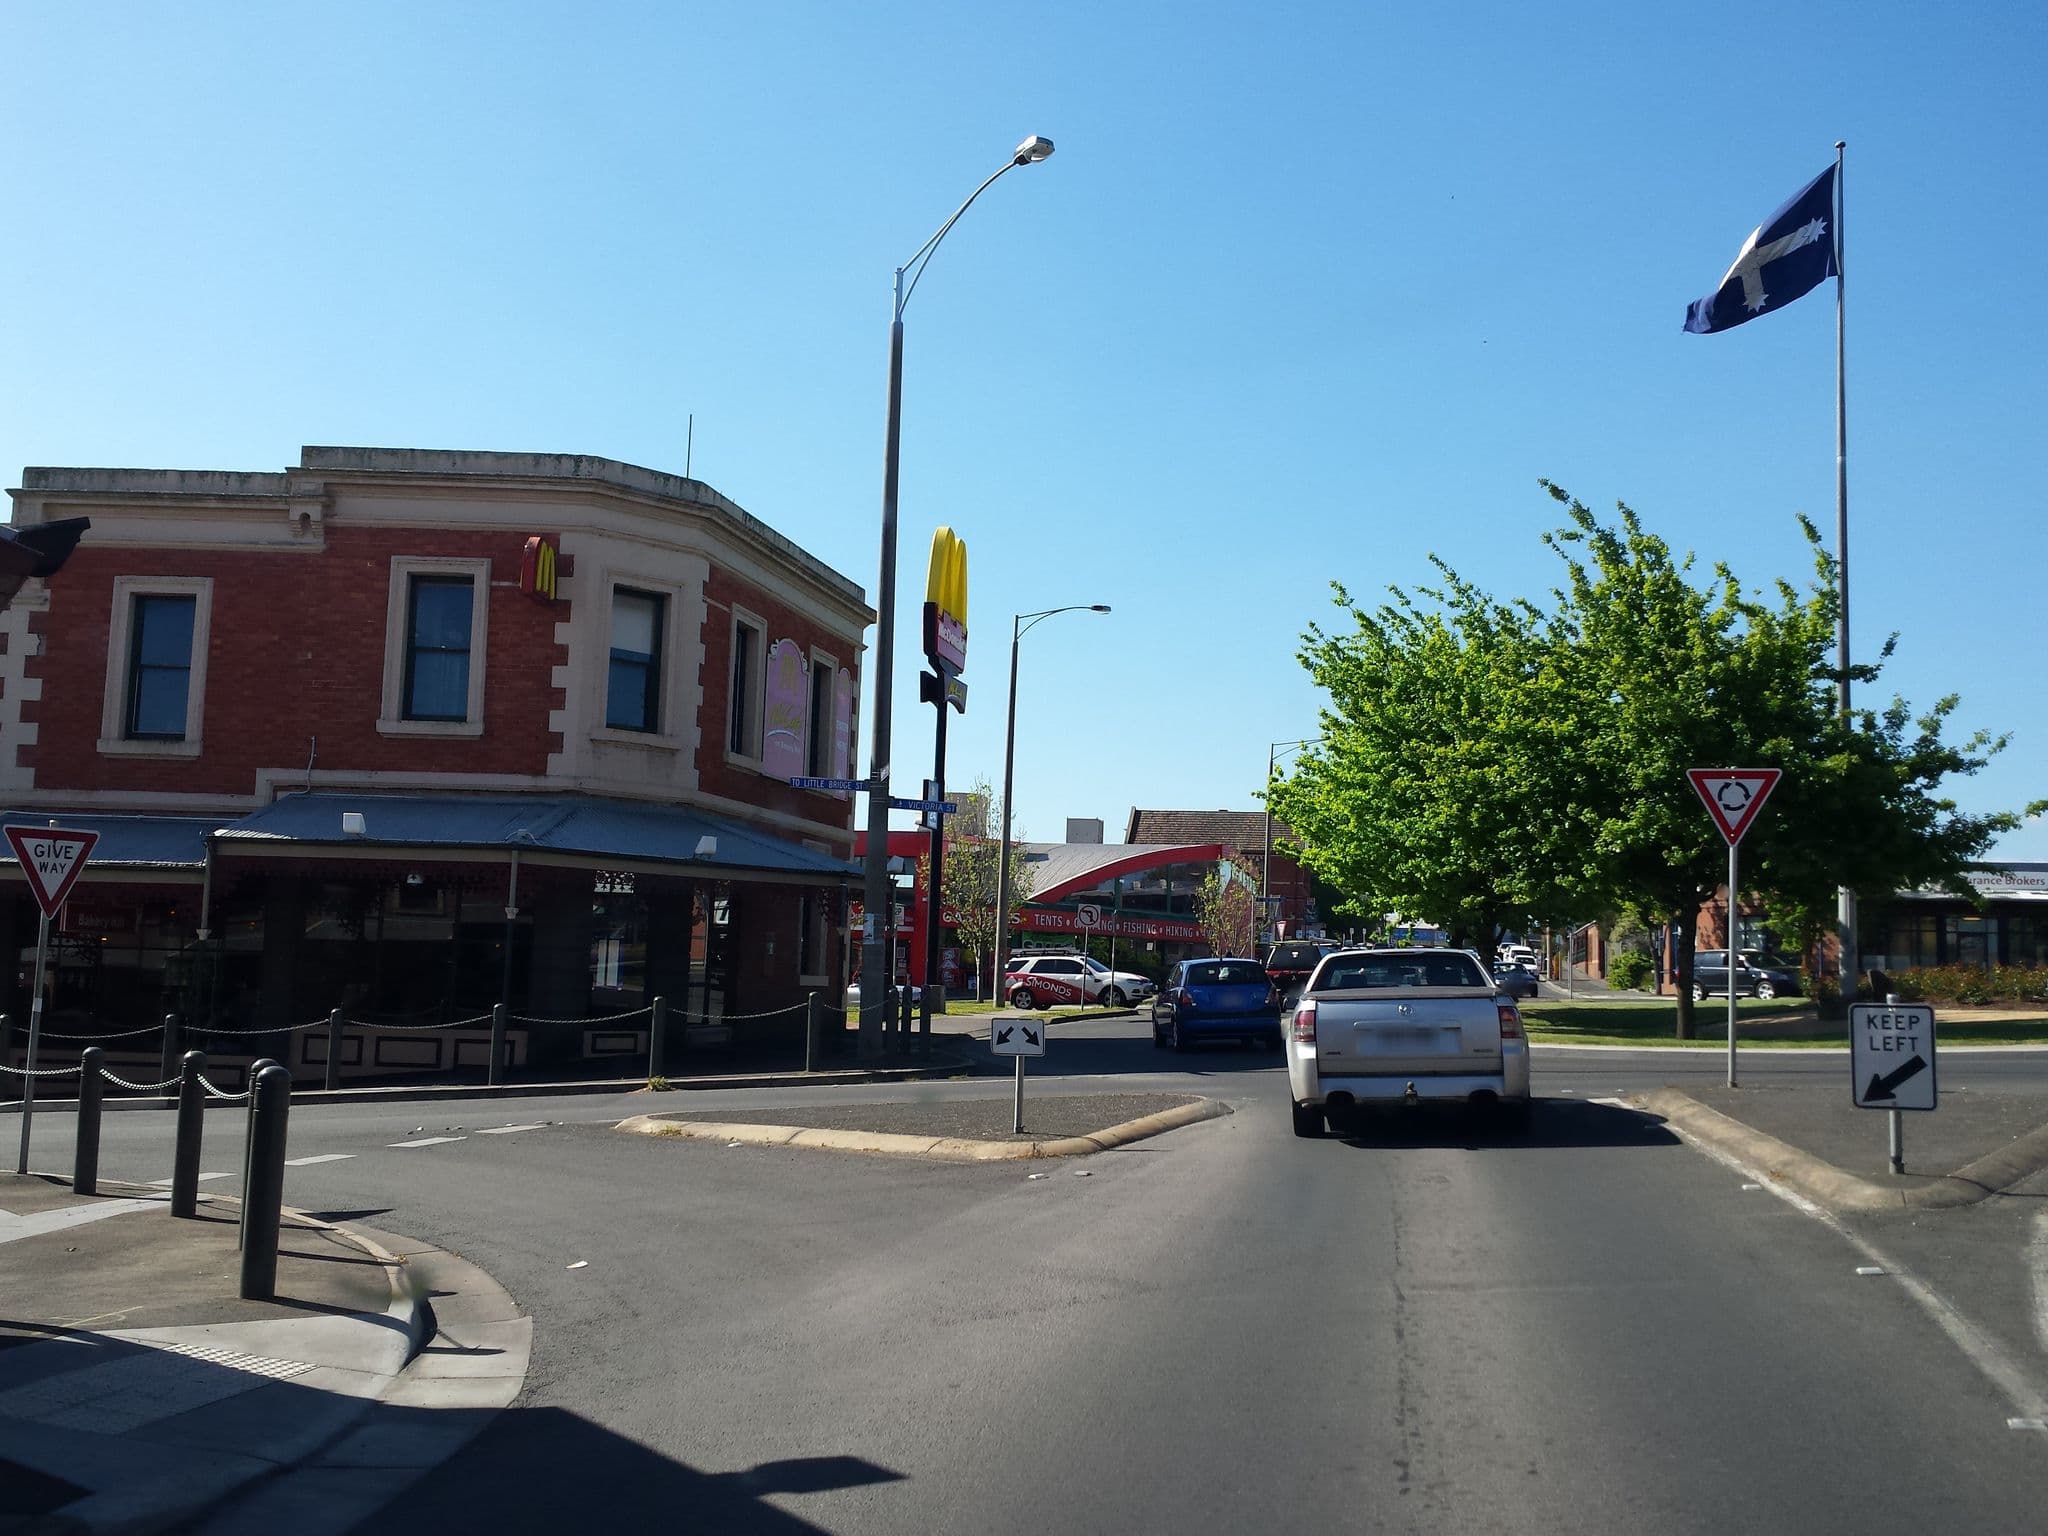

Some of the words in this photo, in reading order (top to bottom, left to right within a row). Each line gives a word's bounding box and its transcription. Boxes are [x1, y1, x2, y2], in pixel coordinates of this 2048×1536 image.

[792, 778, 801, 787] TO
[804, 779, 825, 789] LITTLE
[828, 781, 853, 790] BRIDGE
[855, 782, 864, 790] ST
[908, 800, 943, 812] VICTORIA
[945, 804, 956, 812] ST
[34, 844, 74, 860] GIVE
[39, 861, 67, 874] WAY
[2004, 876, 2046, 886] Brokers
[1034, 913, 1063, 927] TENTS
[1123, 922, 1156, 935] FISHING
[1165, 925, 1193, 938] HIKING
[1026, 976, 1073, 997] SIMONDS
[1866, 1014, 1921, 1030] KEEP
[1869, 1036, 1919, 1052] LEFT
